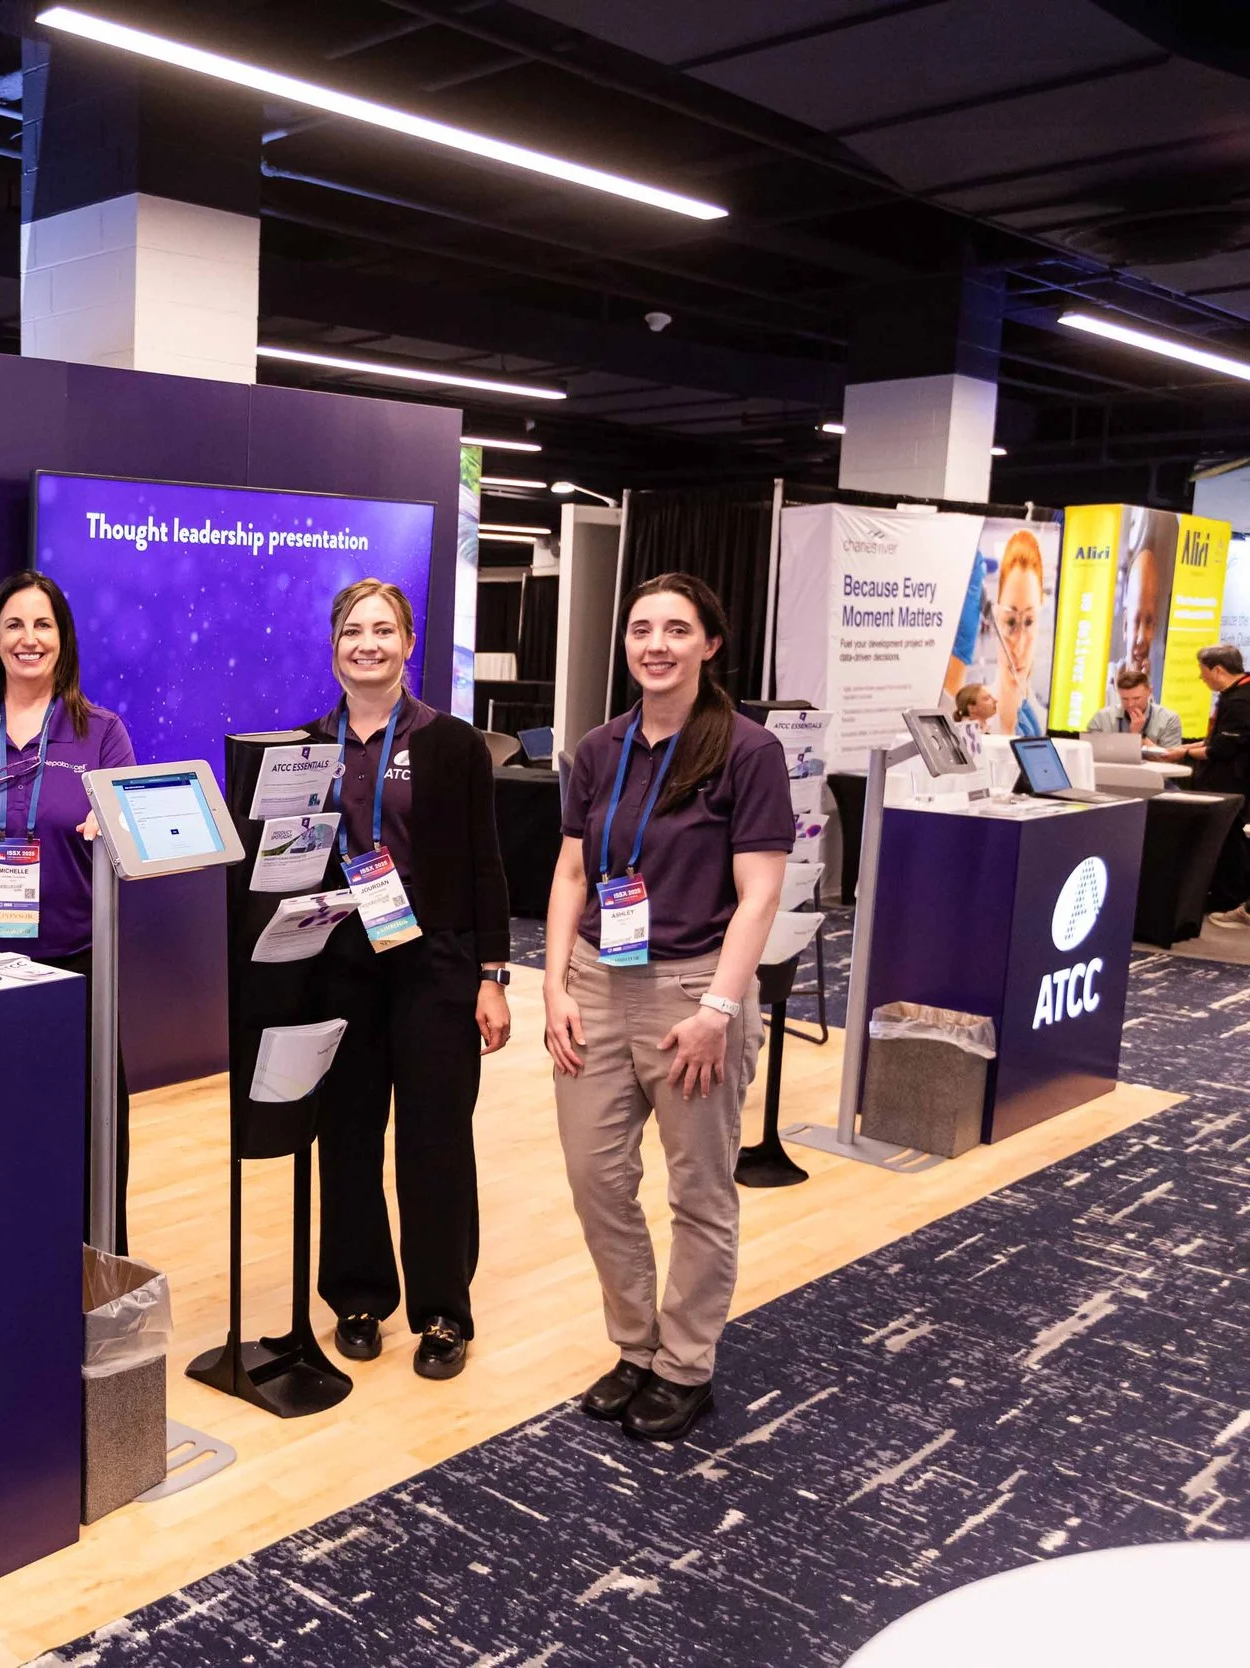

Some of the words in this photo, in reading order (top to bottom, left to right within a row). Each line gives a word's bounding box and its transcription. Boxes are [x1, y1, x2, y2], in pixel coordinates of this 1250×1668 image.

[86, 512, 168, 551] Thought
[173, 518, 264, 556] leadership
[269, 527, 368, 555] presentation
[1075, 546, 1110, 560] Aliri
[1181, 529, 1210, 568] Aliri
[843, 574, 898, 598] Because
[903, 577, 937, 603] Every
[842, 605, 894, 627] Moment
[898, 606, 943, 628] Matters
[840, 638, 853, 648] Fuel
[854, 640, 867, 649] your
[868, 639, 903, 649] development
[904, 639, 923, 649] project
[924, 639, 935, 647] with
[839, 652, 871, 662] data-driven
[272, 762, 292, 772] ATCC
[293, 760, 329, 771] ESSENTIALS
[384, 769, 410, 780] ATC
[360, 865, 375, 875] ISSX
[361, 880, 389, 894] JOURDAN
[611, 909, 635, 918] ASHLEY
[1032, 958, 1103, 1030] ATCC
